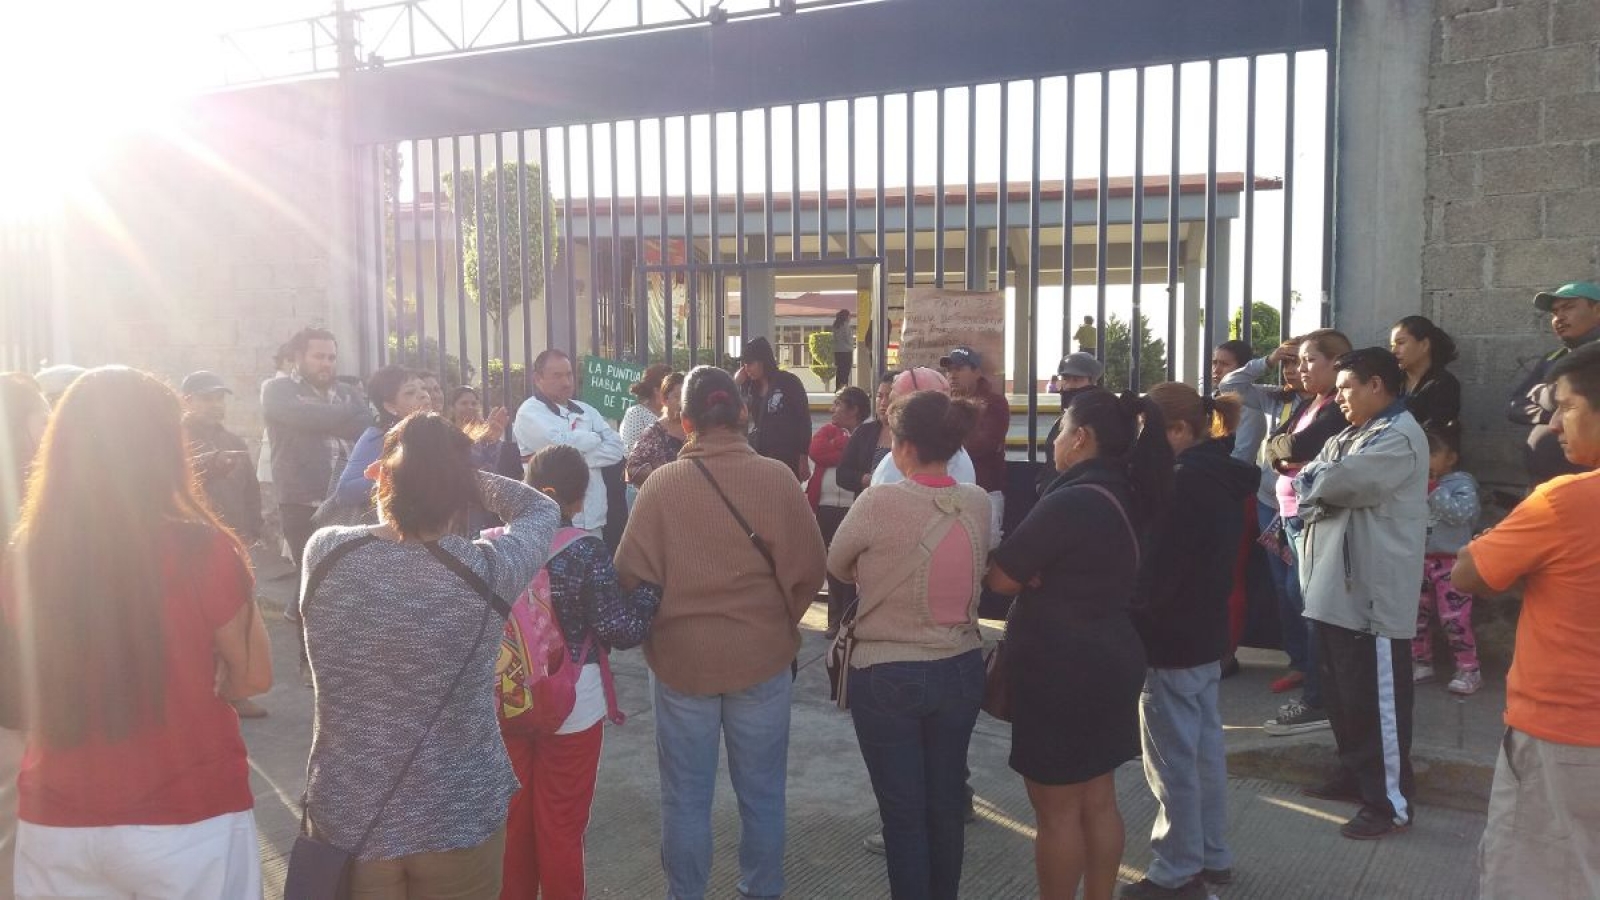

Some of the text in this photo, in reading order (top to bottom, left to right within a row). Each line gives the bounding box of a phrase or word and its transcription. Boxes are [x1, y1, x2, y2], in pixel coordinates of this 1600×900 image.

[588, 361, 602, 374] LA
[591, 375, 622, 392] HABLA
[603, 394, 616, 408] DE
